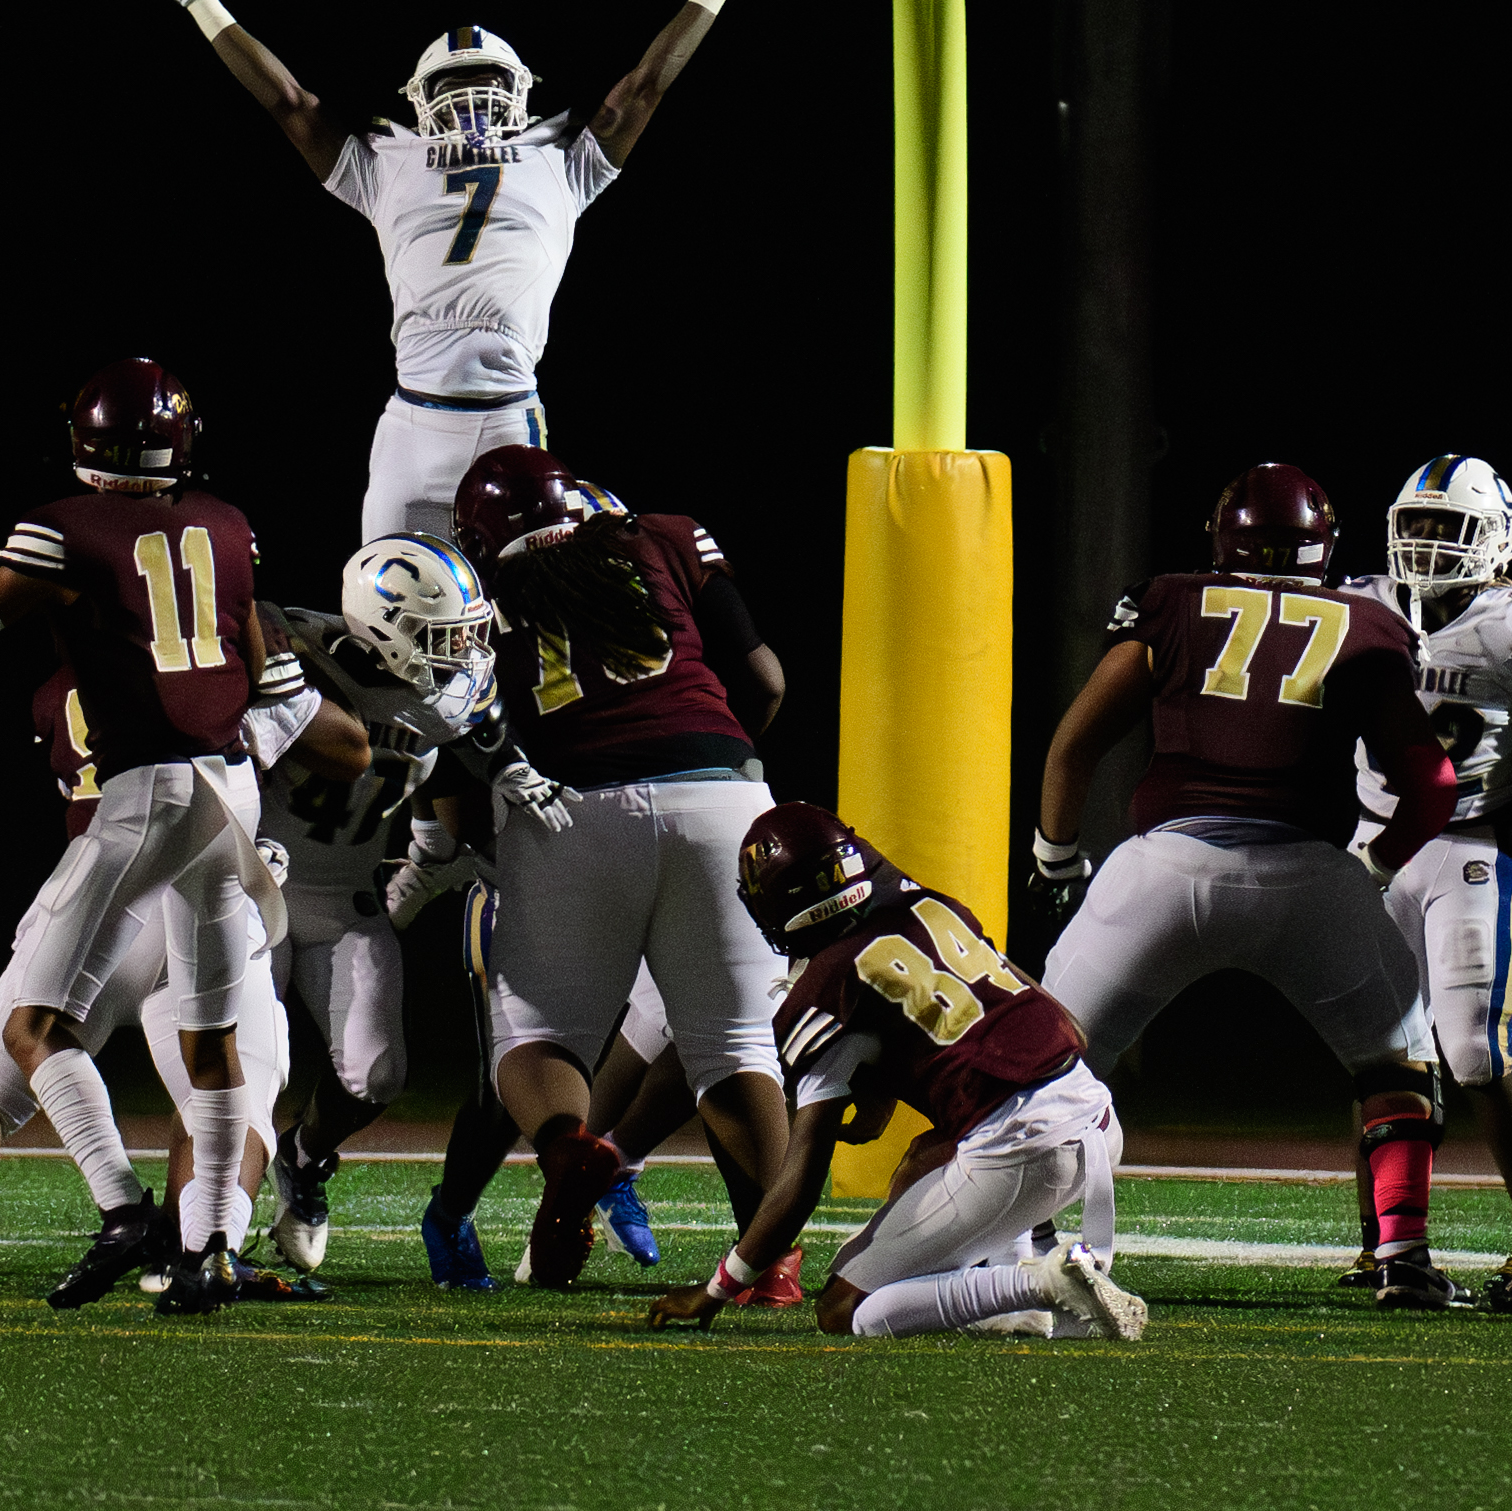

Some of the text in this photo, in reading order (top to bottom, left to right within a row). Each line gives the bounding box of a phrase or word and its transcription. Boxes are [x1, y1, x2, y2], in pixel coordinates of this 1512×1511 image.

[441, 163, 504, 267] 7
[133, 524, 227, 672] 11
[375, 557, 419, 603] C
[1199, 586, 1350, 710] 77
[809, 886, 866, 923] Riddell
[853, 896, 1031, 1046] 84
